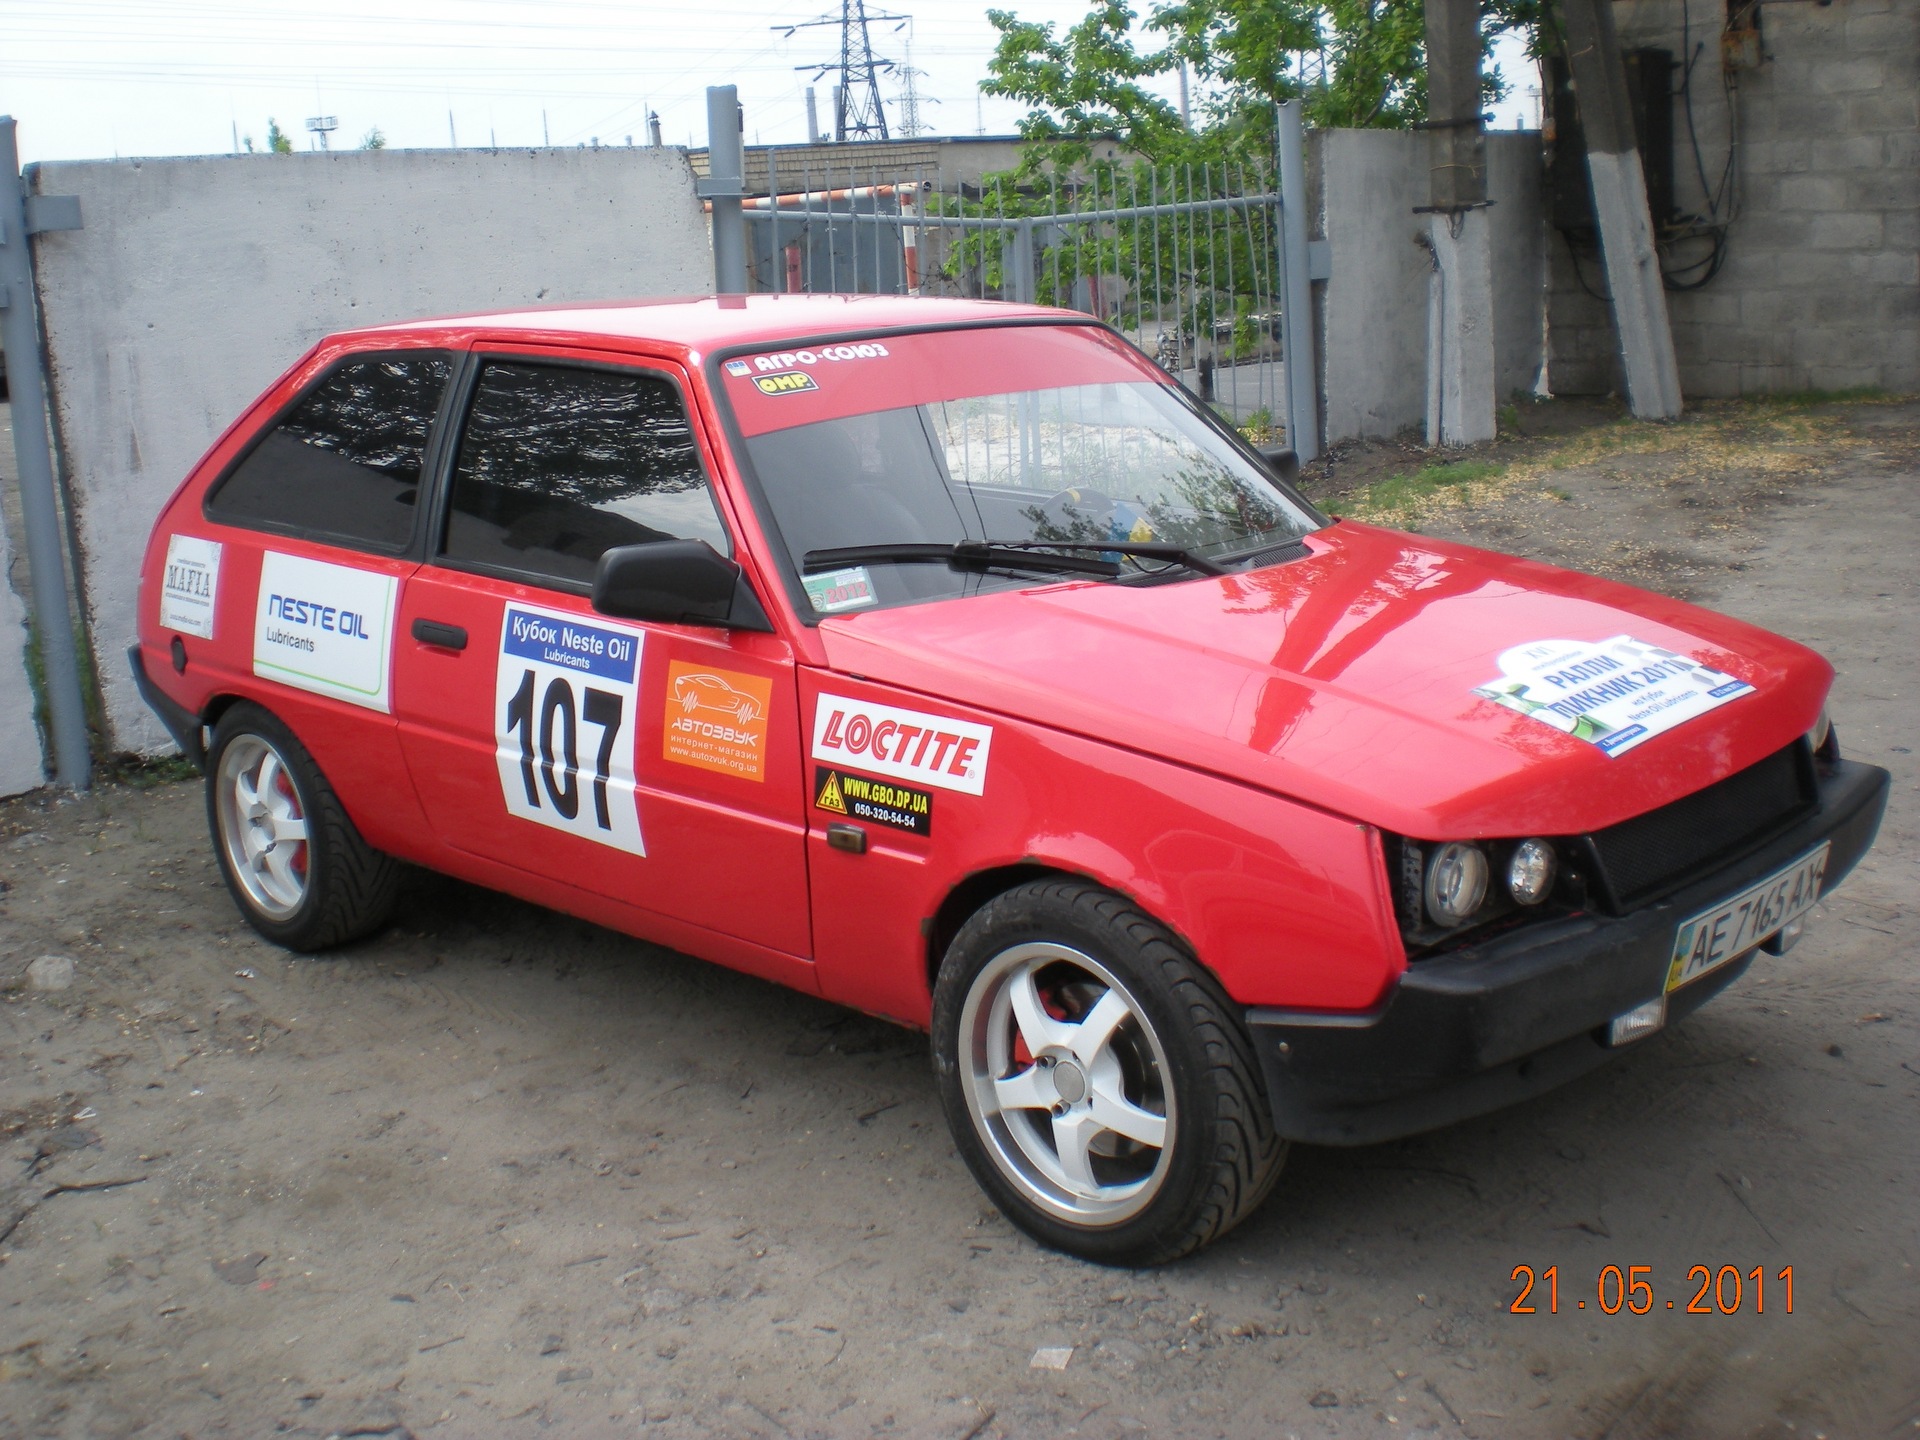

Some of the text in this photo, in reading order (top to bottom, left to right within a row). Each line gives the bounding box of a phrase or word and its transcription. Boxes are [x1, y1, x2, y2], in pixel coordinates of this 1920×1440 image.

[759, 373, 809, 392] OMP
[166, 564, 211, 598] MAFIA
[825, 582, 869, 604] 2012
[269, 593, 369, 640] NESTE OIL
[266, 626, 315, 653] Lubricants
[513, 616, 630, 661] Кубок Neste Oil
[544, 648, 591, 669] Lubricants
[1543, 655, 1625, 689] РАЛЛИ
[1545, 660, 1688, 719] ПИКНИК 2011
[1627, 690, 1699, 721] Neste Oil Lubricants
[671, 717, 758, 747] АВТОЗВУК
[821, 710, 980, 777] LOCTITE
[507, 668, 624, 831] 107
[670, 735, 758, 761] интернет-магазин
[670, 746, 757, 773] www.autozvuk.org.ua
[824, 796, 840, 807] ГАЗ
[843, 777, 928, 814] WWW.GBO.DP.UA
[854, 802, 915, 828] 050-320-54-54
[1687, 912, 1731, 974] AE
[1732, 879, 1789, 951] 7165
